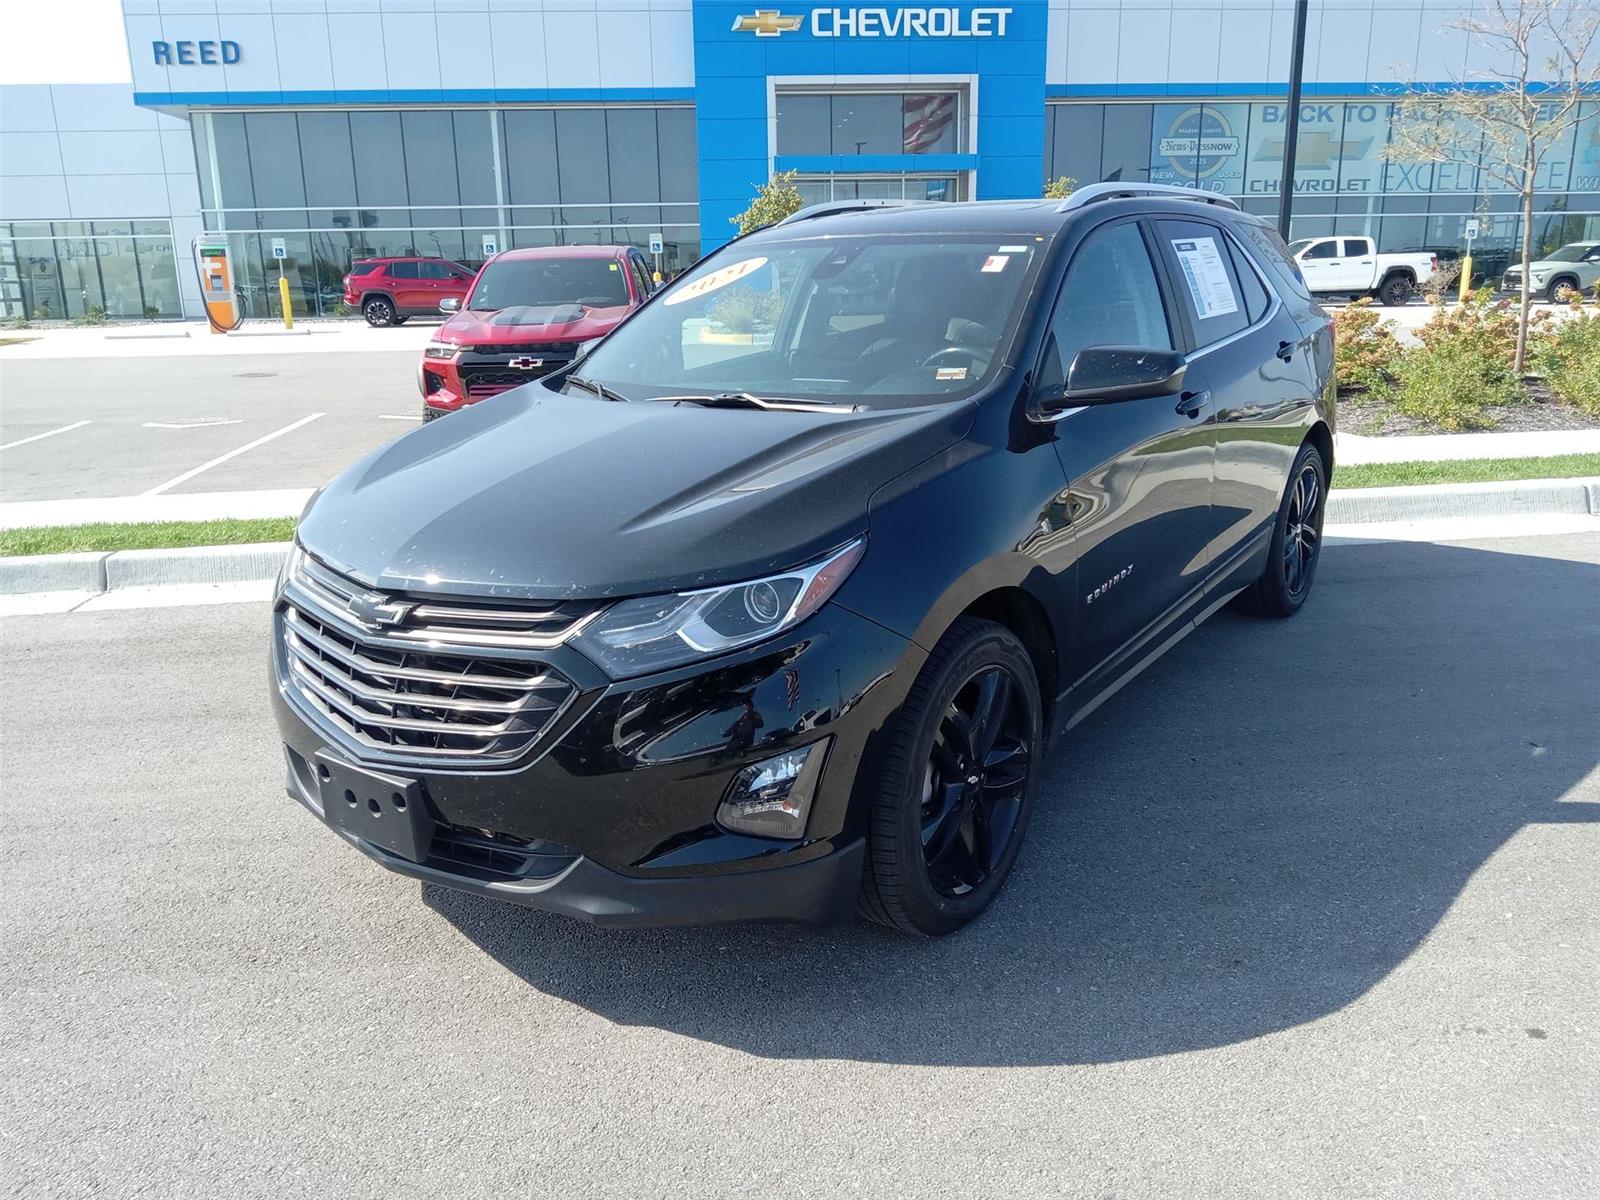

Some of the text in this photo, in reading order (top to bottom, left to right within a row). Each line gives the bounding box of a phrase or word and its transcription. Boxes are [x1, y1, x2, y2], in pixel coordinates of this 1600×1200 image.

[811, 7, 1013, 37] CHEVROLET
[152, 40, 241, 65] REED
[1342, 104, 1377, 122] TO
[1151, 171, 1175, 179] NEW
[1250, 178, 1371, 192] CHVROLET
[1379, 162, 1566, 190] EXCELLENCE
[1087, 564, 1133, 604] EQUINOX
